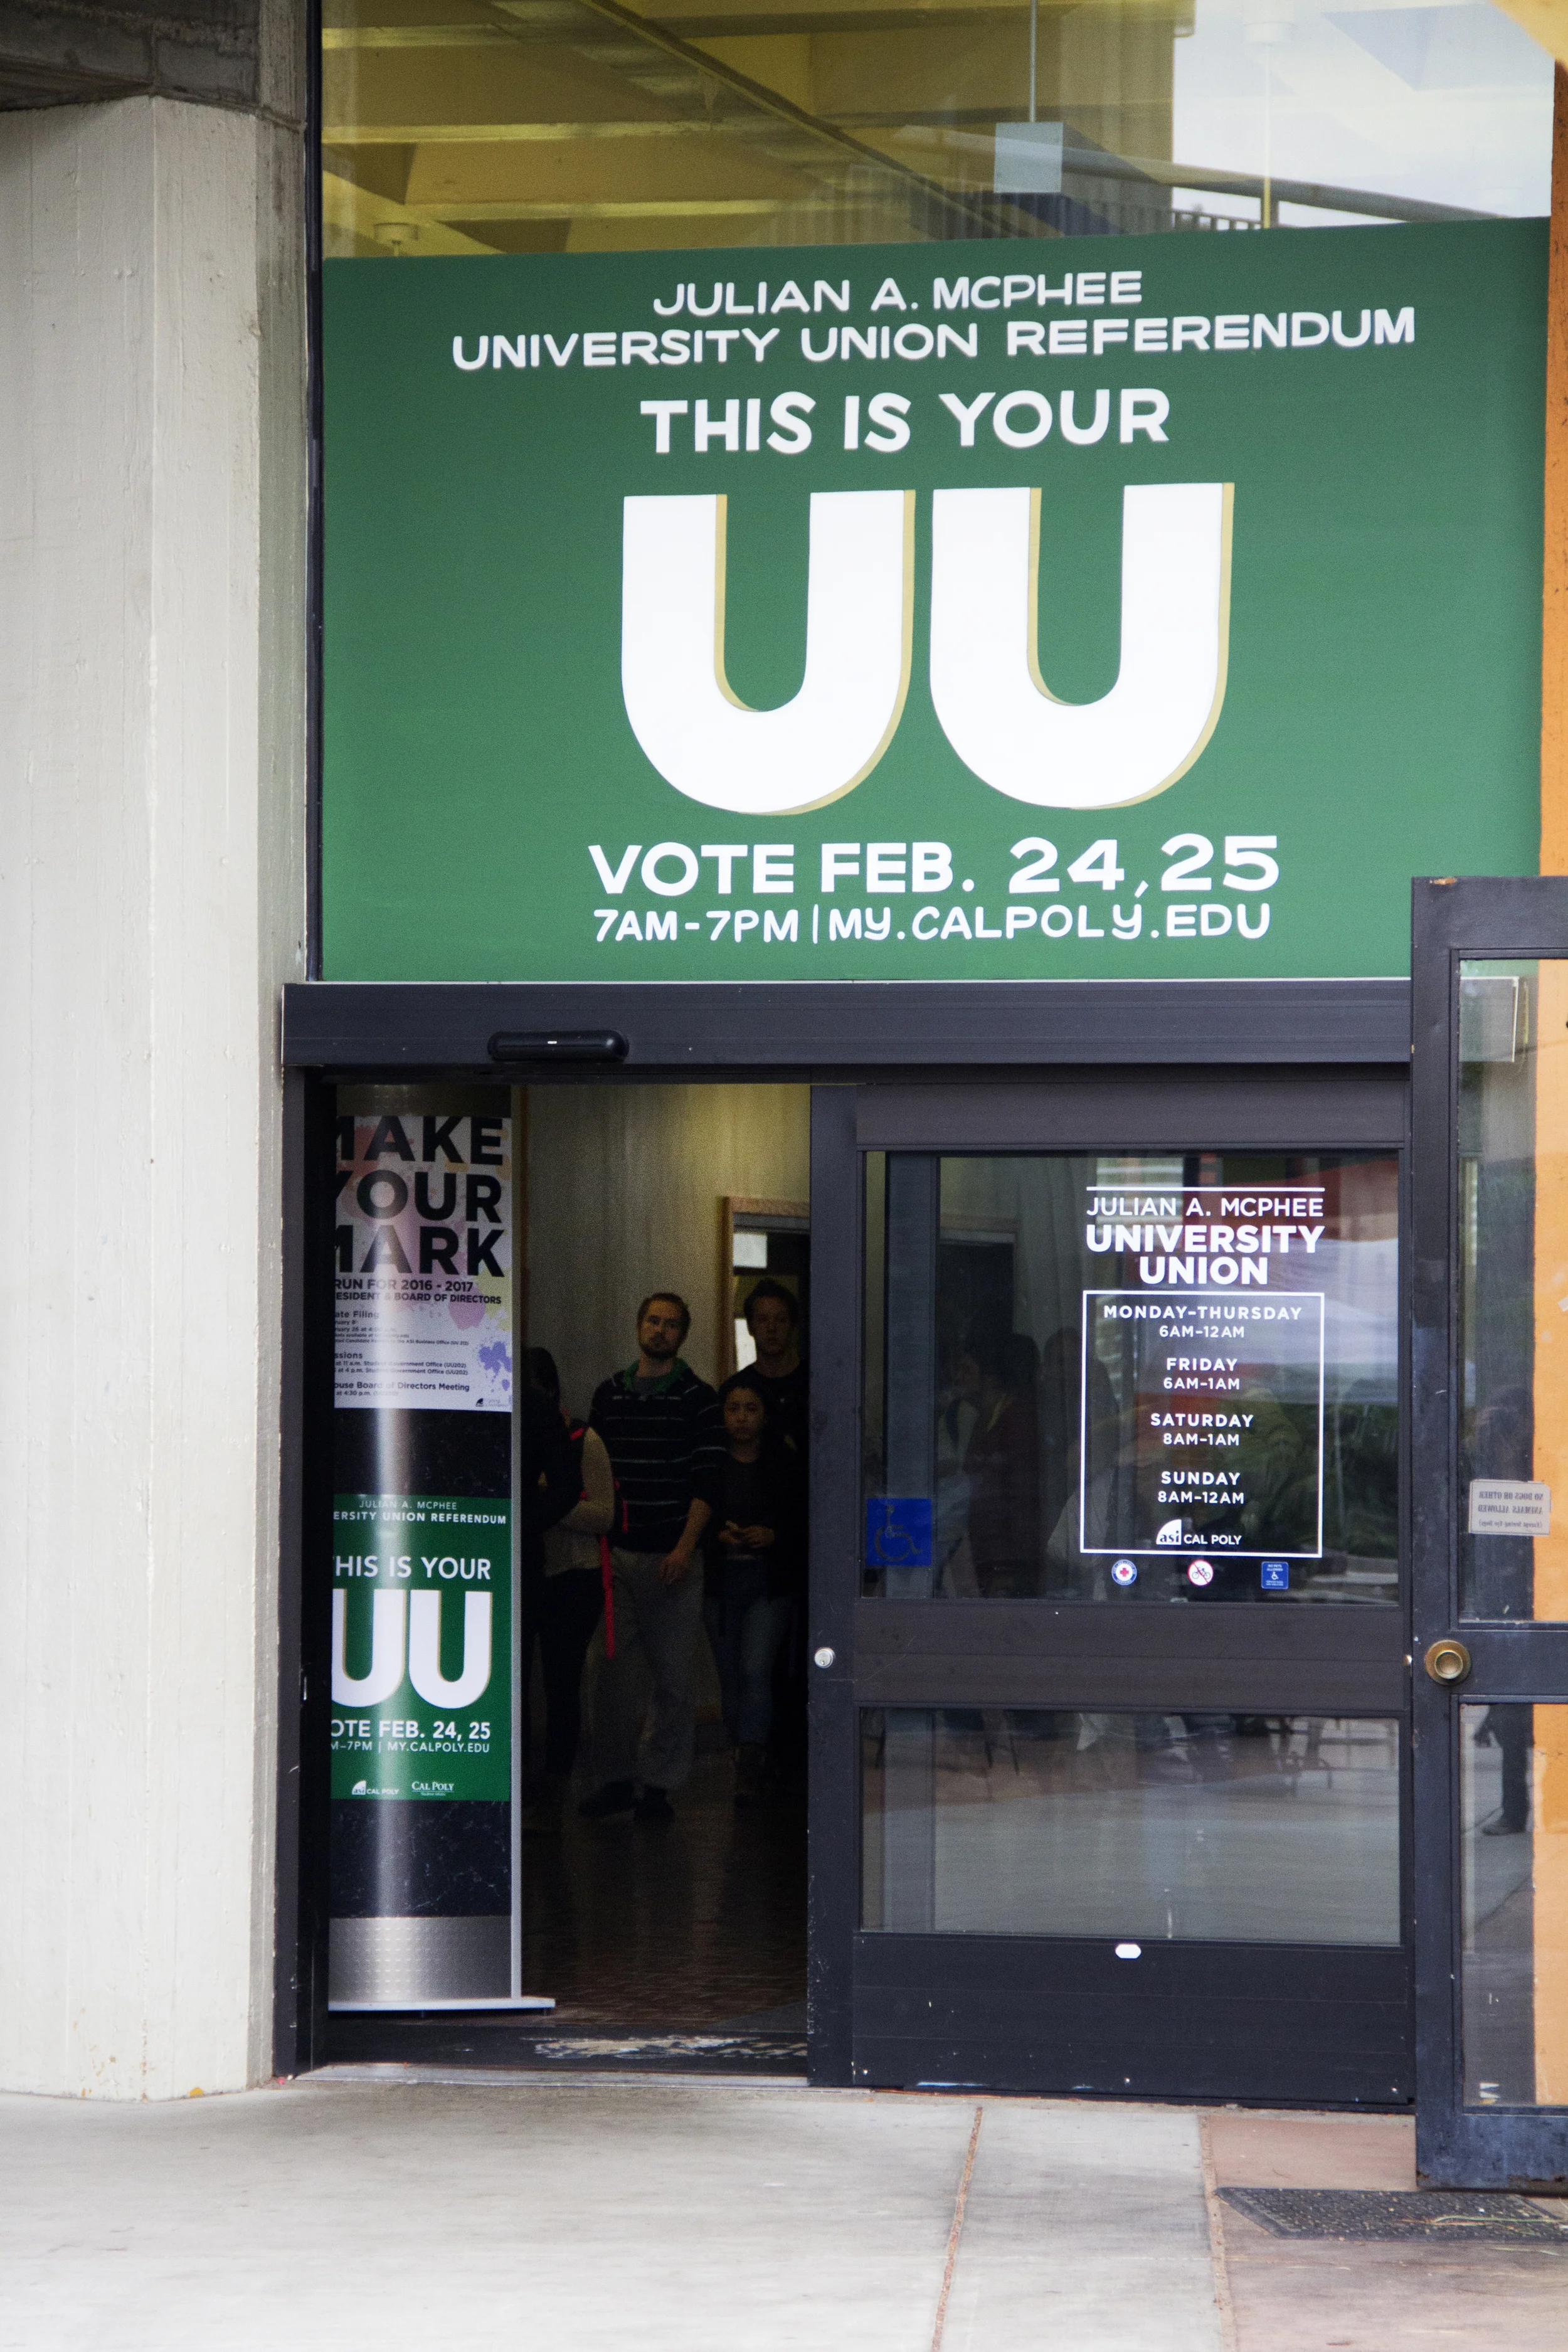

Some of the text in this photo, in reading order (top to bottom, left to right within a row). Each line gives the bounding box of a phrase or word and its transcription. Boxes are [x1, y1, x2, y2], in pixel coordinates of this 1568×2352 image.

[654, 271, 1142, 316] JULIAN A. MCPHEE
[453, 307, 1415, 369] UNIVERSITY UNION REFERENDUM
[640, 388, 1169, 453] THIS IS YOUR
[622, 482, 1234, 815] UU
[588, 842, 794, 896] VOTE
[821, 840, 974, 893] FEB.
[1087, 1197, 1323, 1217] JULIAN A. MCPHEE
[1086, 1224, 1325, 1253] UNIVERSITY
[1140, 1256, 1268, 1285] UNION
[335, 1279, 363, 1290] RUN
[368, 1279, 397, 1290] FOR
[401, 1279, 433, 1290] 2016
[445, 1281, 474, 1292] 2017
[395, 1293, 431, 1301] BOARD
[434, 1294, 447, 1302] OF
[450, 1295, 502, 1304] DIRECTORS
[1167, 1358, 1238, 1372] FRIDAY
[439, 1383, 470, 1392] Meeting
[1151, 1413, 1254, 1428] SATURDAY
[1162, 1471, 1240, 1485] SUNDAY
[359, 1500, 457, 1510] JULIAN A. MCPHEE
[383, 1512, 425, 1522] UNION
[431, 1512, 506, 1525] REFERENDUM
[1184, 1534, 1208, 1544] CAL
[1211, 1535, 1242, 1545] POLY
[333, 1555, 491, 1581] HIS IS YOUR
[332, 1588, 493, 1709] UU
[379, 1720, 425, 1738] FEB.
[433, 1721, 462, 1742] 24,
[469, 1722, 491, 1739] 25
[387, 1742, 490, 1753] MY.CALPOLY.EDU
